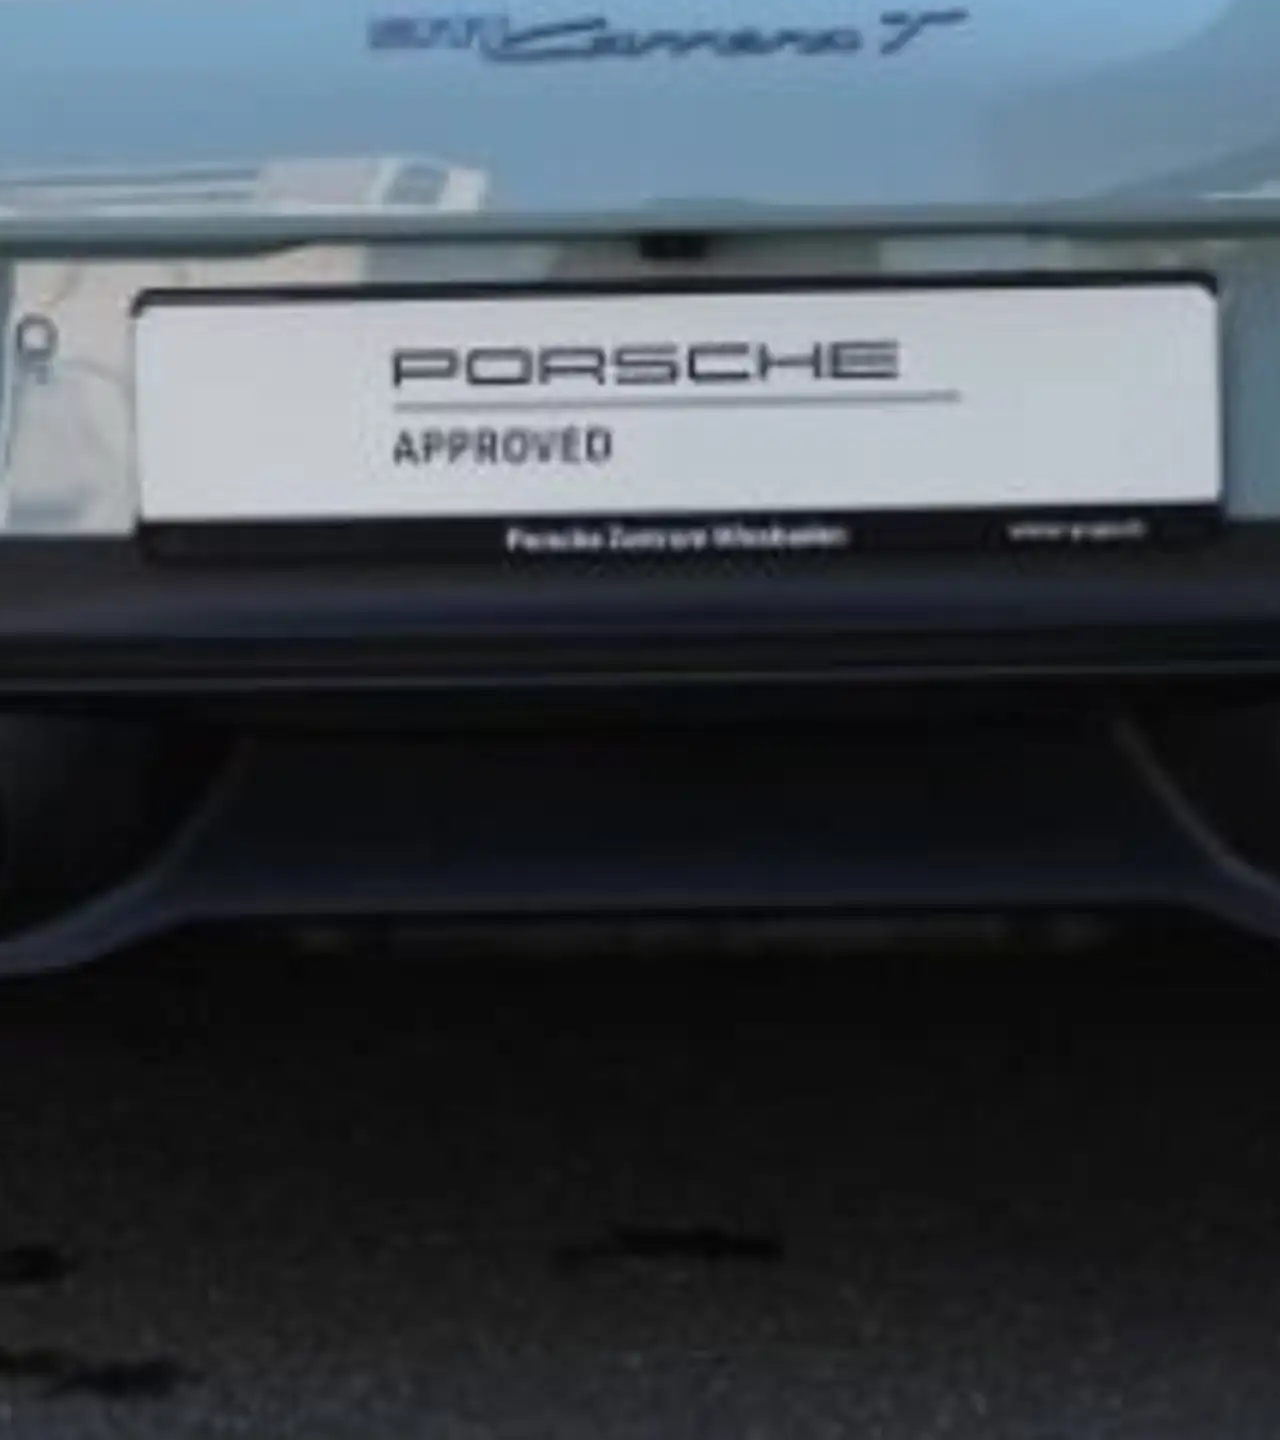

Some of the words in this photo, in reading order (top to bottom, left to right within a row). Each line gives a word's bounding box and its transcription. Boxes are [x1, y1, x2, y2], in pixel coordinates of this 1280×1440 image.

[879, 10, 968, 55] T
[391, 339, 901, 388] PORSCHE
[391, 425, 613, 465] APPROVED
